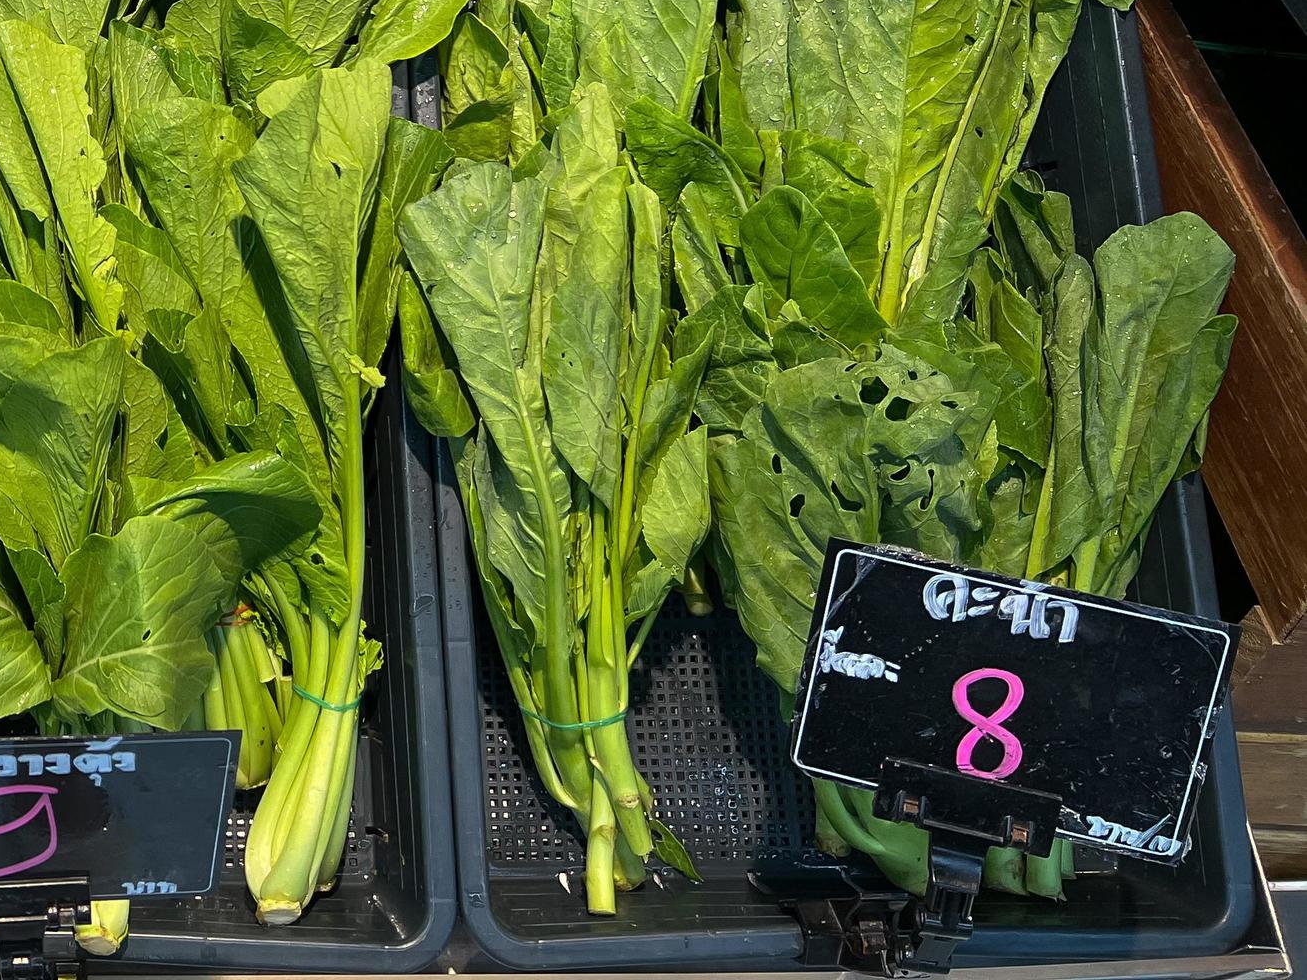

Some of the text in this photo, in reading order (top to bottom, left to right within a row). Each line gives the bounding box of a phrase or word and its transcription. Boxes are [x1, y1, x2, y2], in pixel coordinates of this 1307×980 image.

[922, 573, 1080, 644] คะน้า
[952, 667, 1025, 779] 8
[121, 880, 178, 896] บาท
